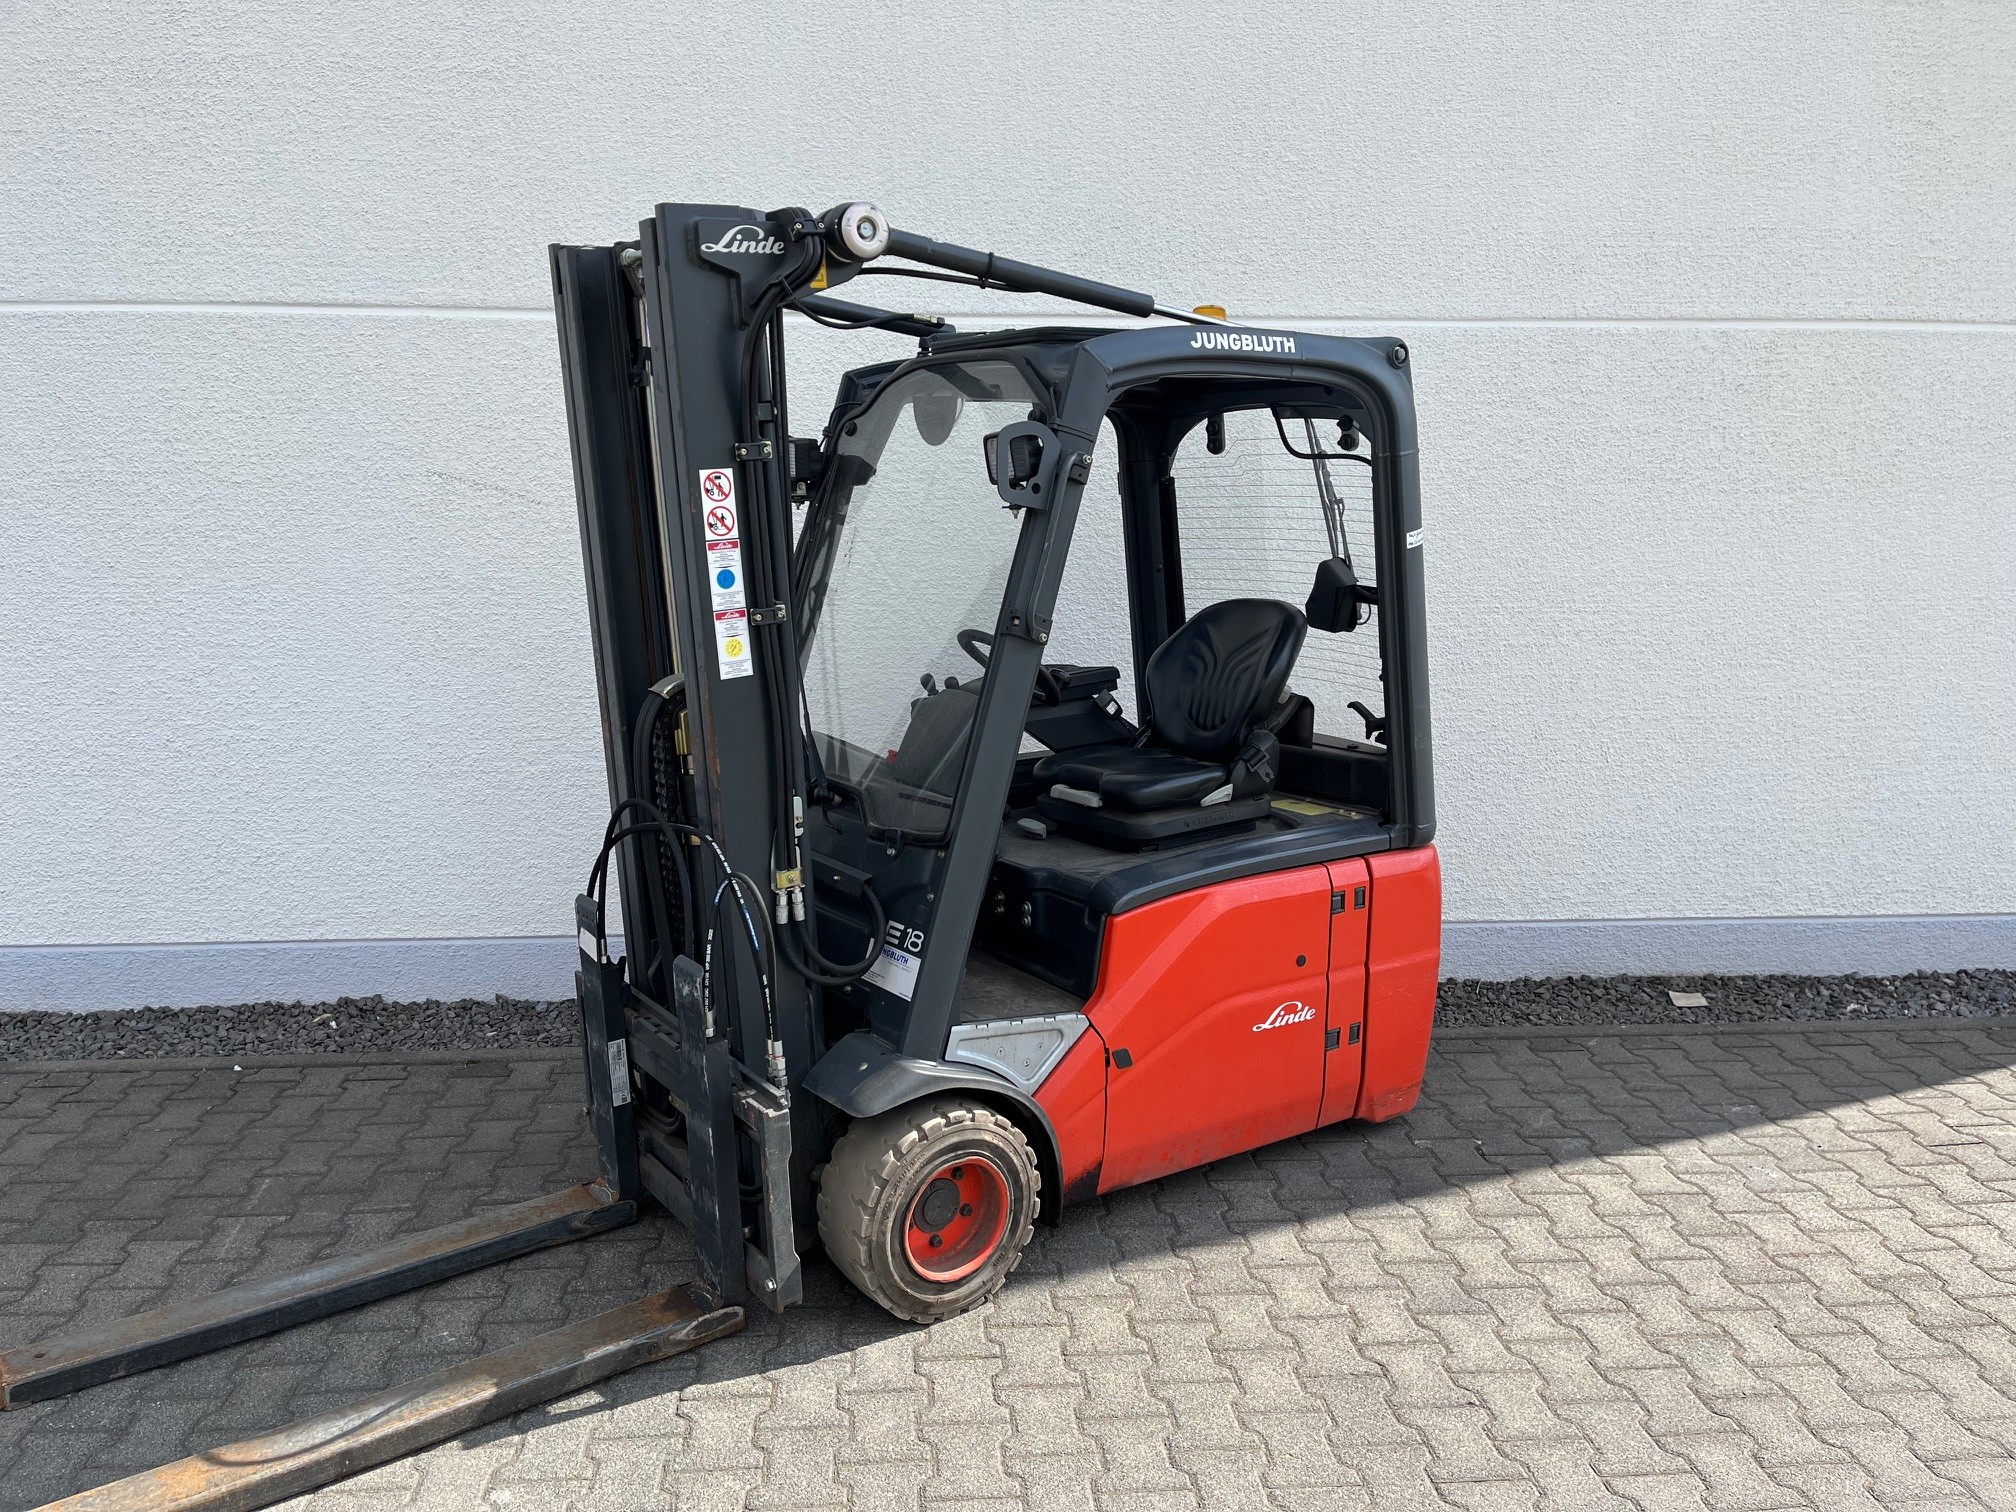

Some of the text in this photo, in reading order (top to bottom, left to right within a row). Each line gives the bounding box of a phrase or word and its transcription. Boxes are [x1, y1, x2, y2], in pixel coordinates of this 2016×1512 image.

[700, 225, 785, 255] Linde
[1190, 331, 1296, 353] JUNGBLUTH
[881, 948, 909, 965] NGBLUTH
[1252, 1001, 1316, 1032] Linde
